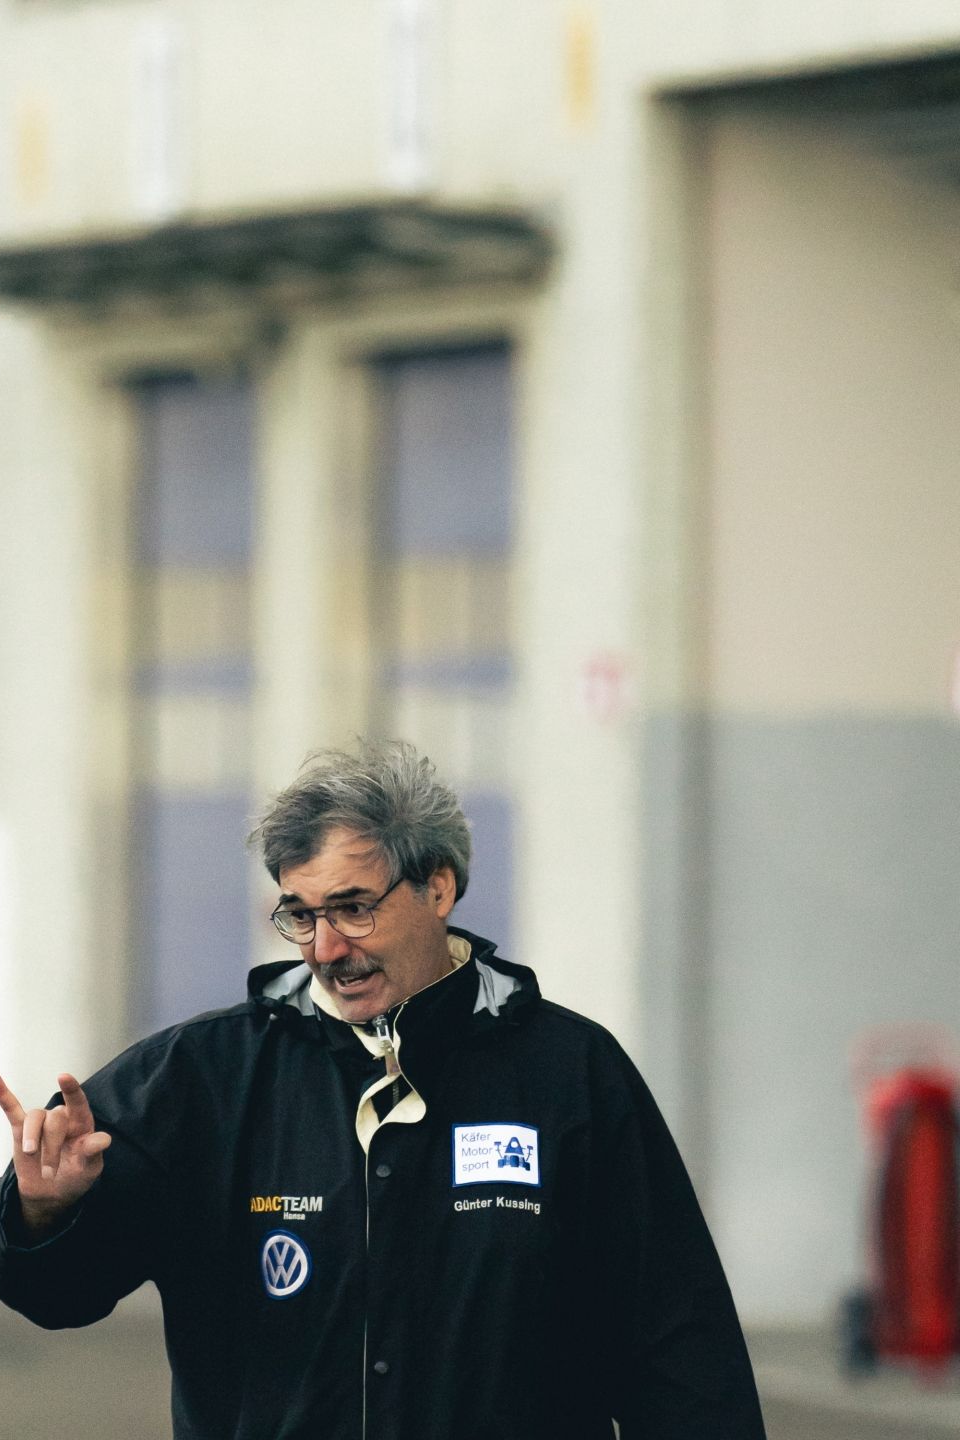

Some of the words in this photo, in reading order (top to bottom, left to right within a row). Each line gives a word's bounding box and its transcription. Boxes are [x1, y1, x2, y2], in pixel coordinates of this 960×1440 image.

[461, 1132, 491, 1143] Käfer
[461, 1147, 493, 1157] Motor
[462, 1161, 490, 1172] sport
[454, 1198, 493, 1212] Günter
[496, 1196, 541, 1214] Kussing
[263, 1237, 306, 1292] VW
